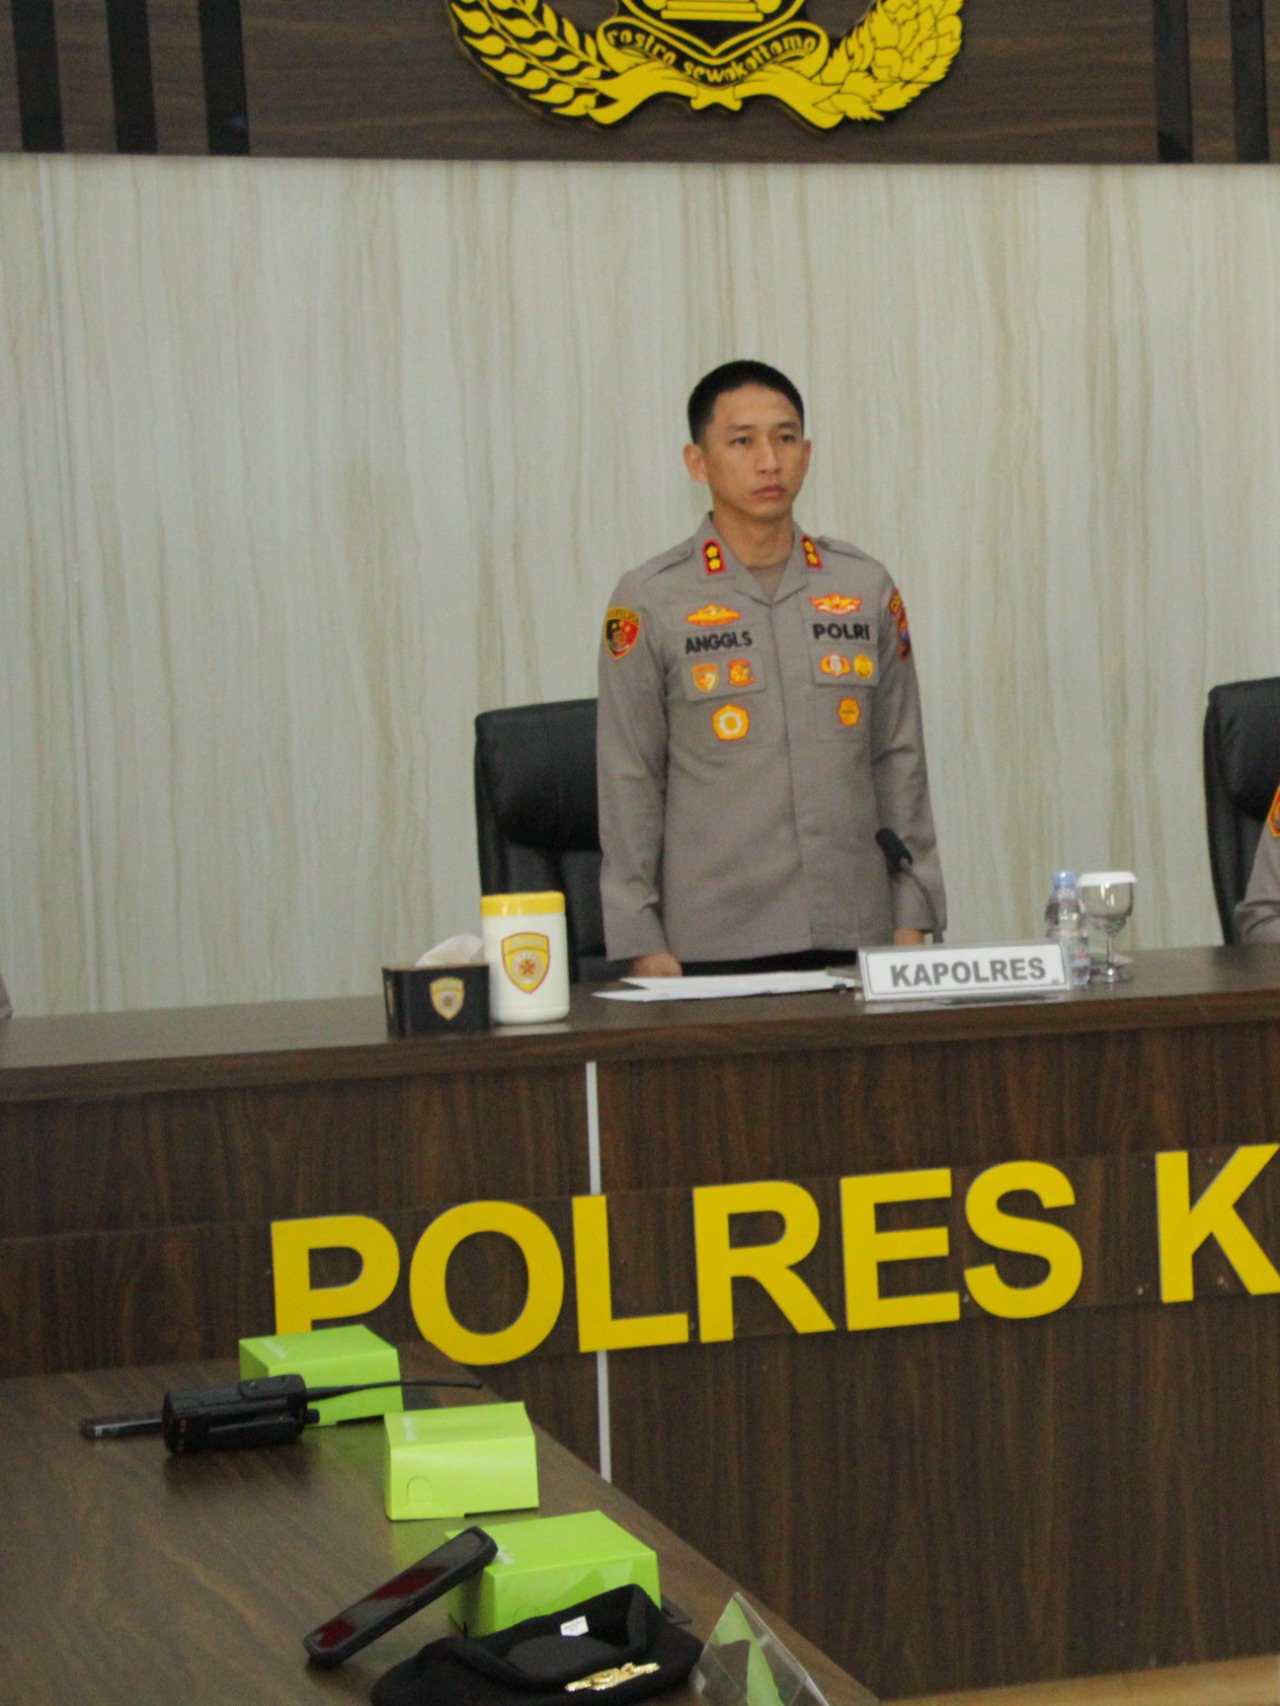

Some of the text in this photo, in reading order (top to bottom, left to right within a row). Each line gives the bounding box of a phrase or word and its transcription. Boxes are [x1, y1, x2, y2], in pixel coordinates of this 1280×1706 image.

[812, 622, 871, 641] POLRI
[890, 957, 1047, 988] KAPOLRES
[270, 1160, 1084, 1366] POLRES
